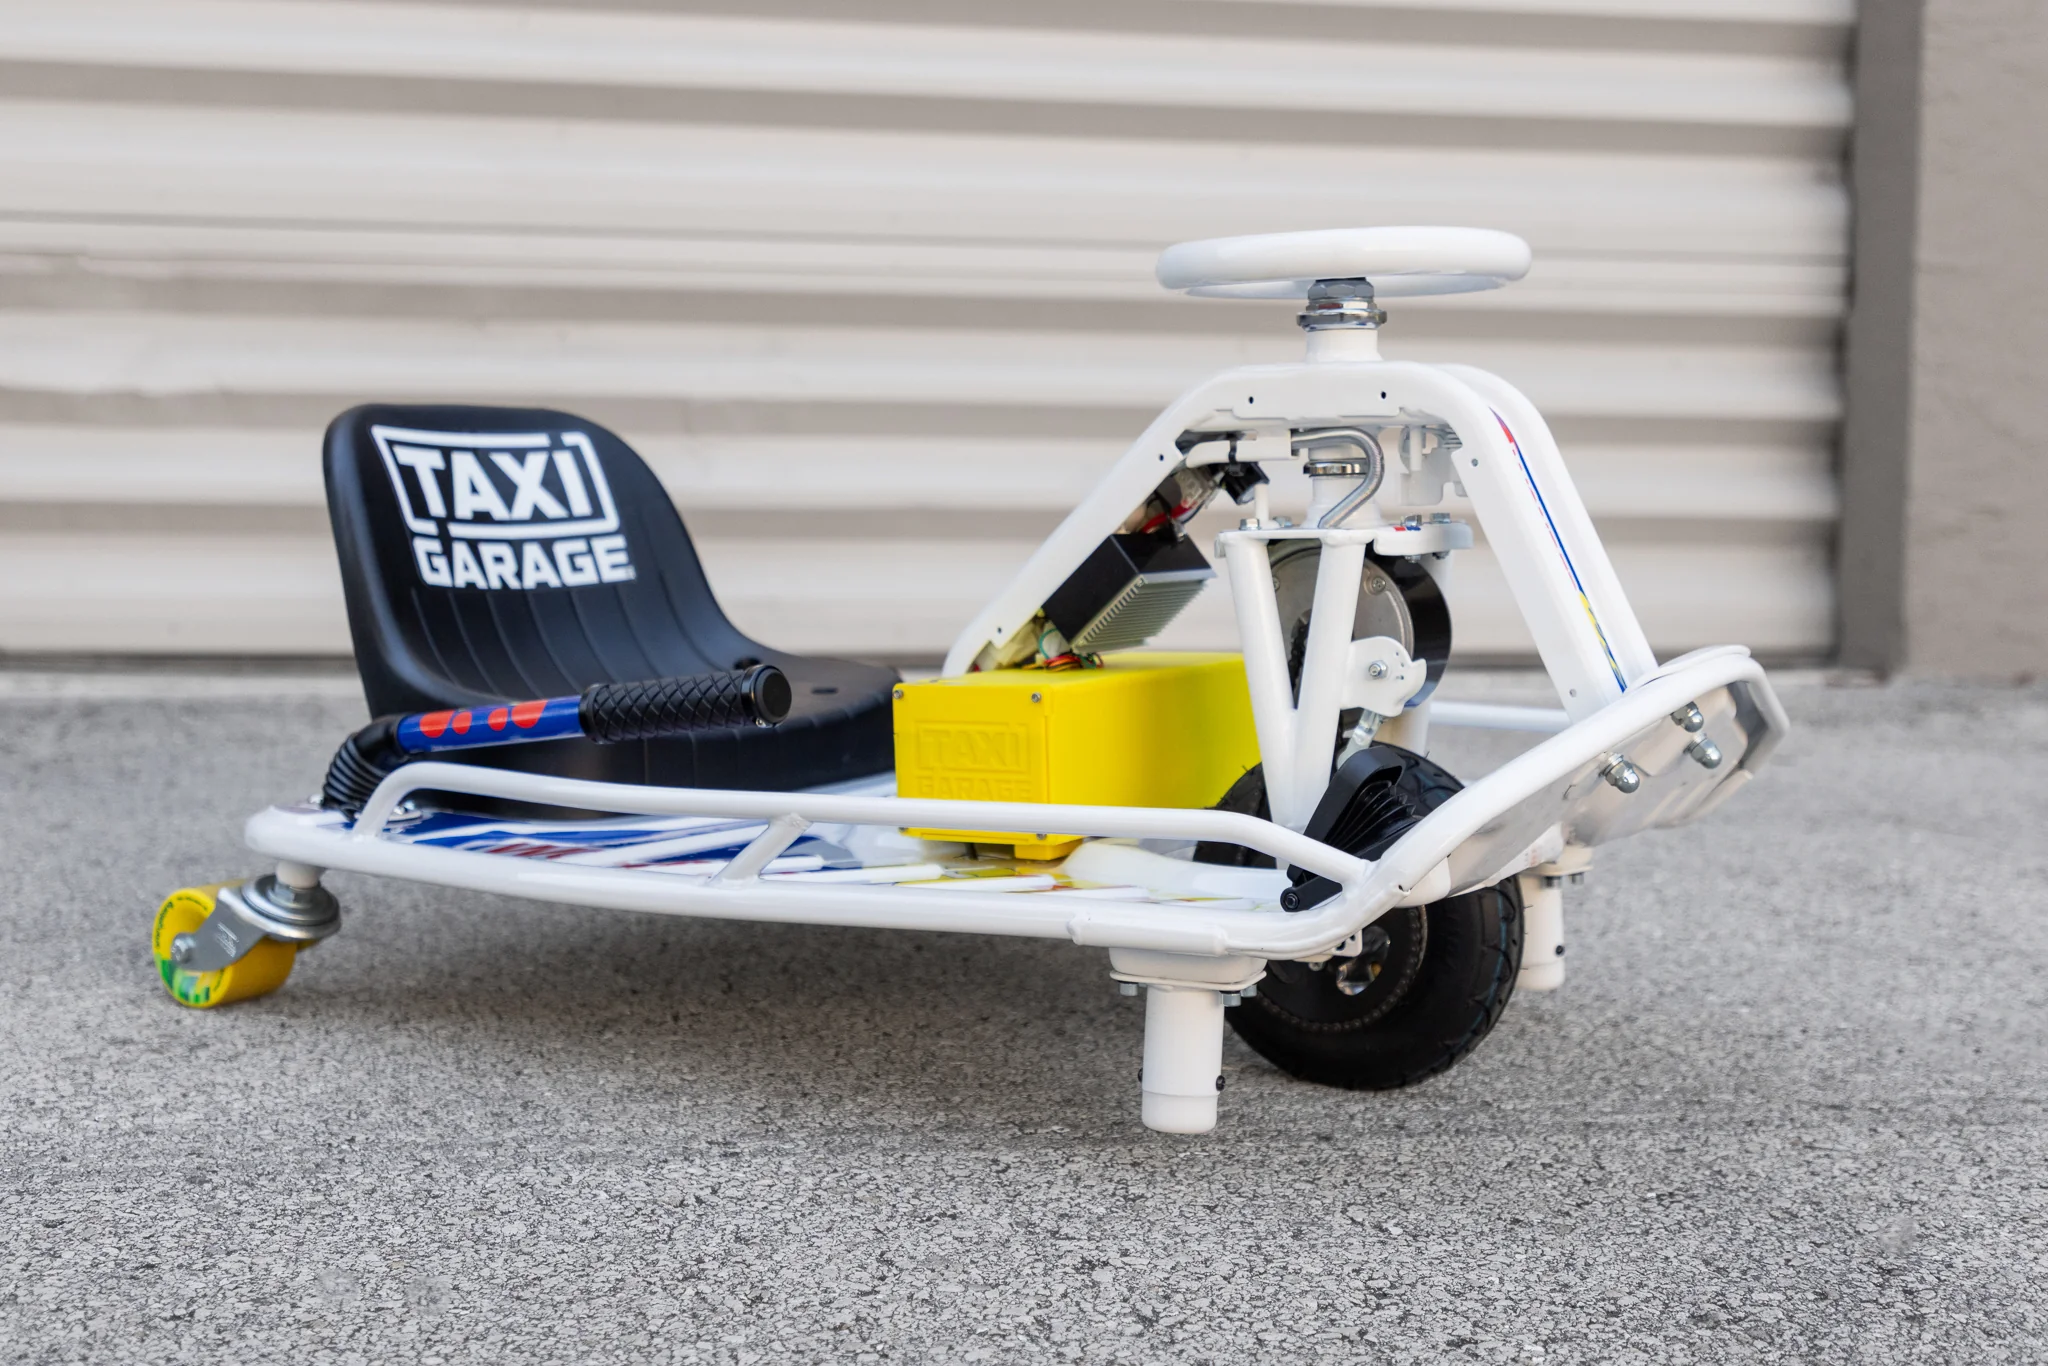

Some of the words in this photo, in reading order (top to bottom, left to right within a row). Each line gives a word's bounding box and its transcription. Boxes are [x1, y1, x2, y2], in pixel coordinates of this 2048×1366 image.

[391, 443, 593, 521] TAXI
[412, 533, 637, 590] GARAGE
[921, 728, 1022, 769] TAXI
[915, 775, 1033, 802] GARAGE
